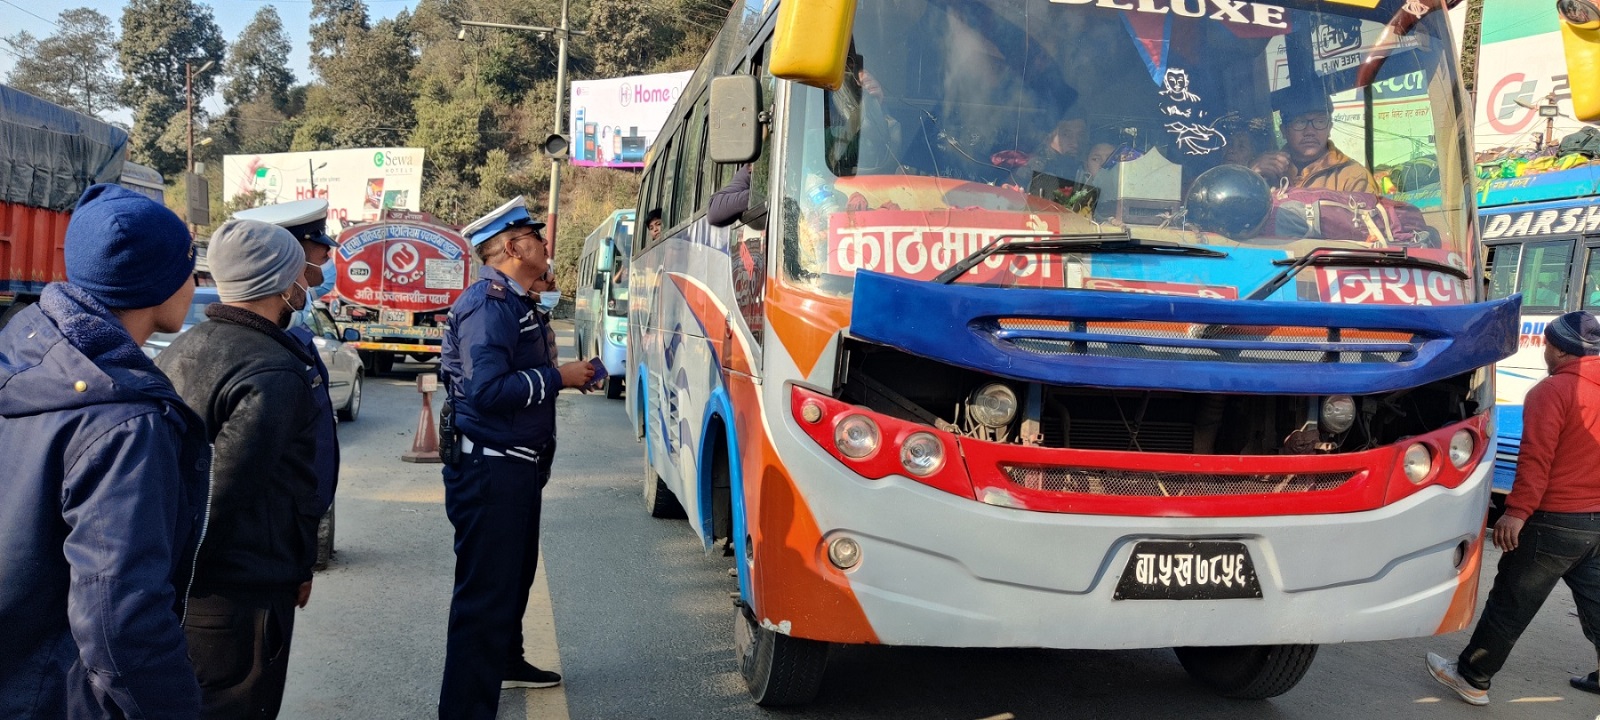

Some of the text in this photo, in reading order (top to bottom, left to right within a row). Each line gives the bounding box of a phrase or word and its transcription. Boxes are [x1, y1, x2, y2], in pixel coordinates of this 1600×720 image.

[1049, 0, 1288, 28] LUXE
[374, 151, 413, 167] eSewa
[296, 184, 329, 200] Hotel
[354, 287, 374, 300] अति
[429, 291, 450, 304] पदार्थ
